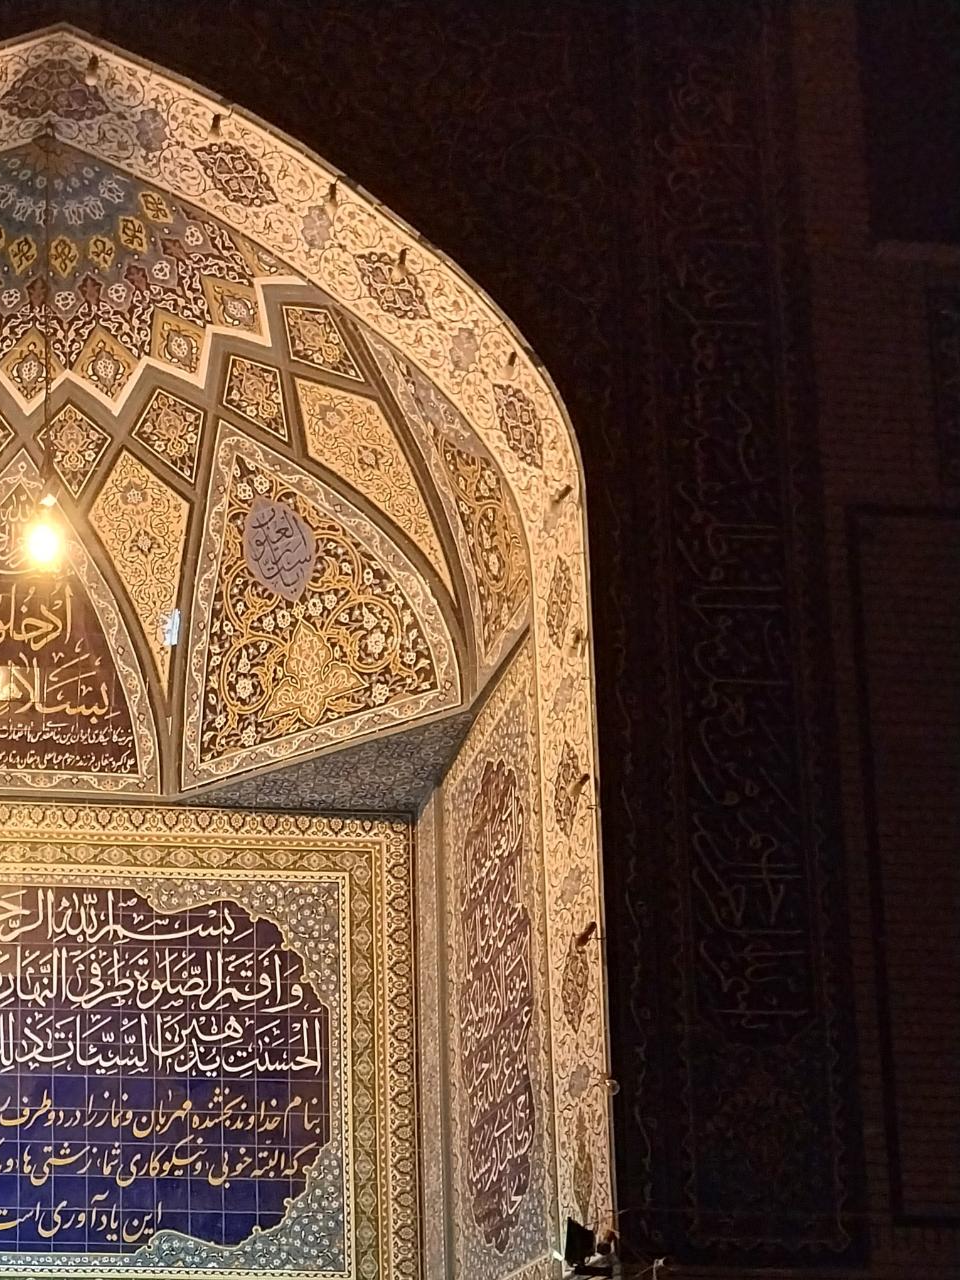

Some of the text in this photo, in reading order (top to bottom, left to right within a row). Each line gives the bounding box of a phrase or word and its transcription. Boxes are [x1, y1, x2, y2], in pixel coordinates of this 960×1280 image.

[0, 1088, 53, 1130] طرف
[63, 1109, 81, 1128] در
[83, 1093, 98, 1127] را
[132, 1088, 193, 1138] مهربان
[191, 1086, 244, 1131] بخشنده
[230, 1098, 282, 1135] خداوند
[282, 1095, 322, 1138] بنام
[281, 1140, 318, 1178] که
[121, 1200, 163, 1243] این
